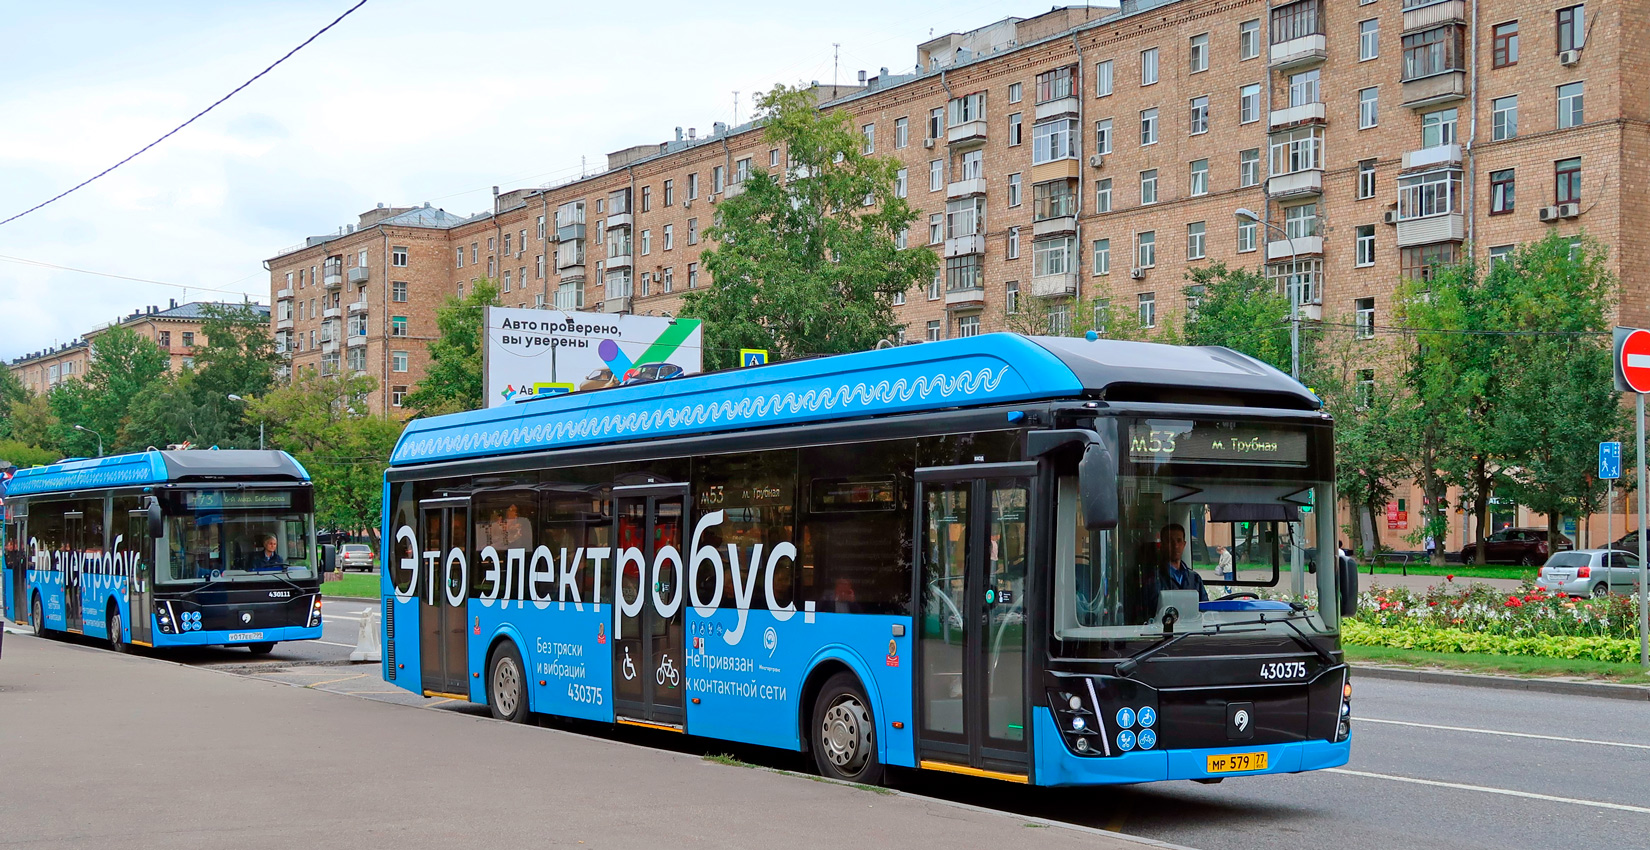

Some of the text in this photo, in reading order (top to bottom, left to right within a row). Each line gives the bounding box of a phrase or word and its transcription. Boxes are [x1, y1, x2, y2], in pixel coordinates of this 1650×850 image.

[502, 317, 622, 337] Авто проверено,
[502, 334, 589, 349] вы уверены
[1230, 437, 1278, 452] Трубная
[752, 485, 780, 500] Трубная
[30, 536, 51, 584] Это
[395, 509, 815, 645] Это электробус.
[537, 637, 583, 659] Без тряски
[537, 662, 586, 678] и вибраций
[685, 648, 754, 673] Не привязан
[1260, 661, 1306, 680] 430375
[567, 683, 603, 705] 430375
[685, 677, 787, 701] к контактной сети
[1212, 753, 1265, 770] МР 579 77
